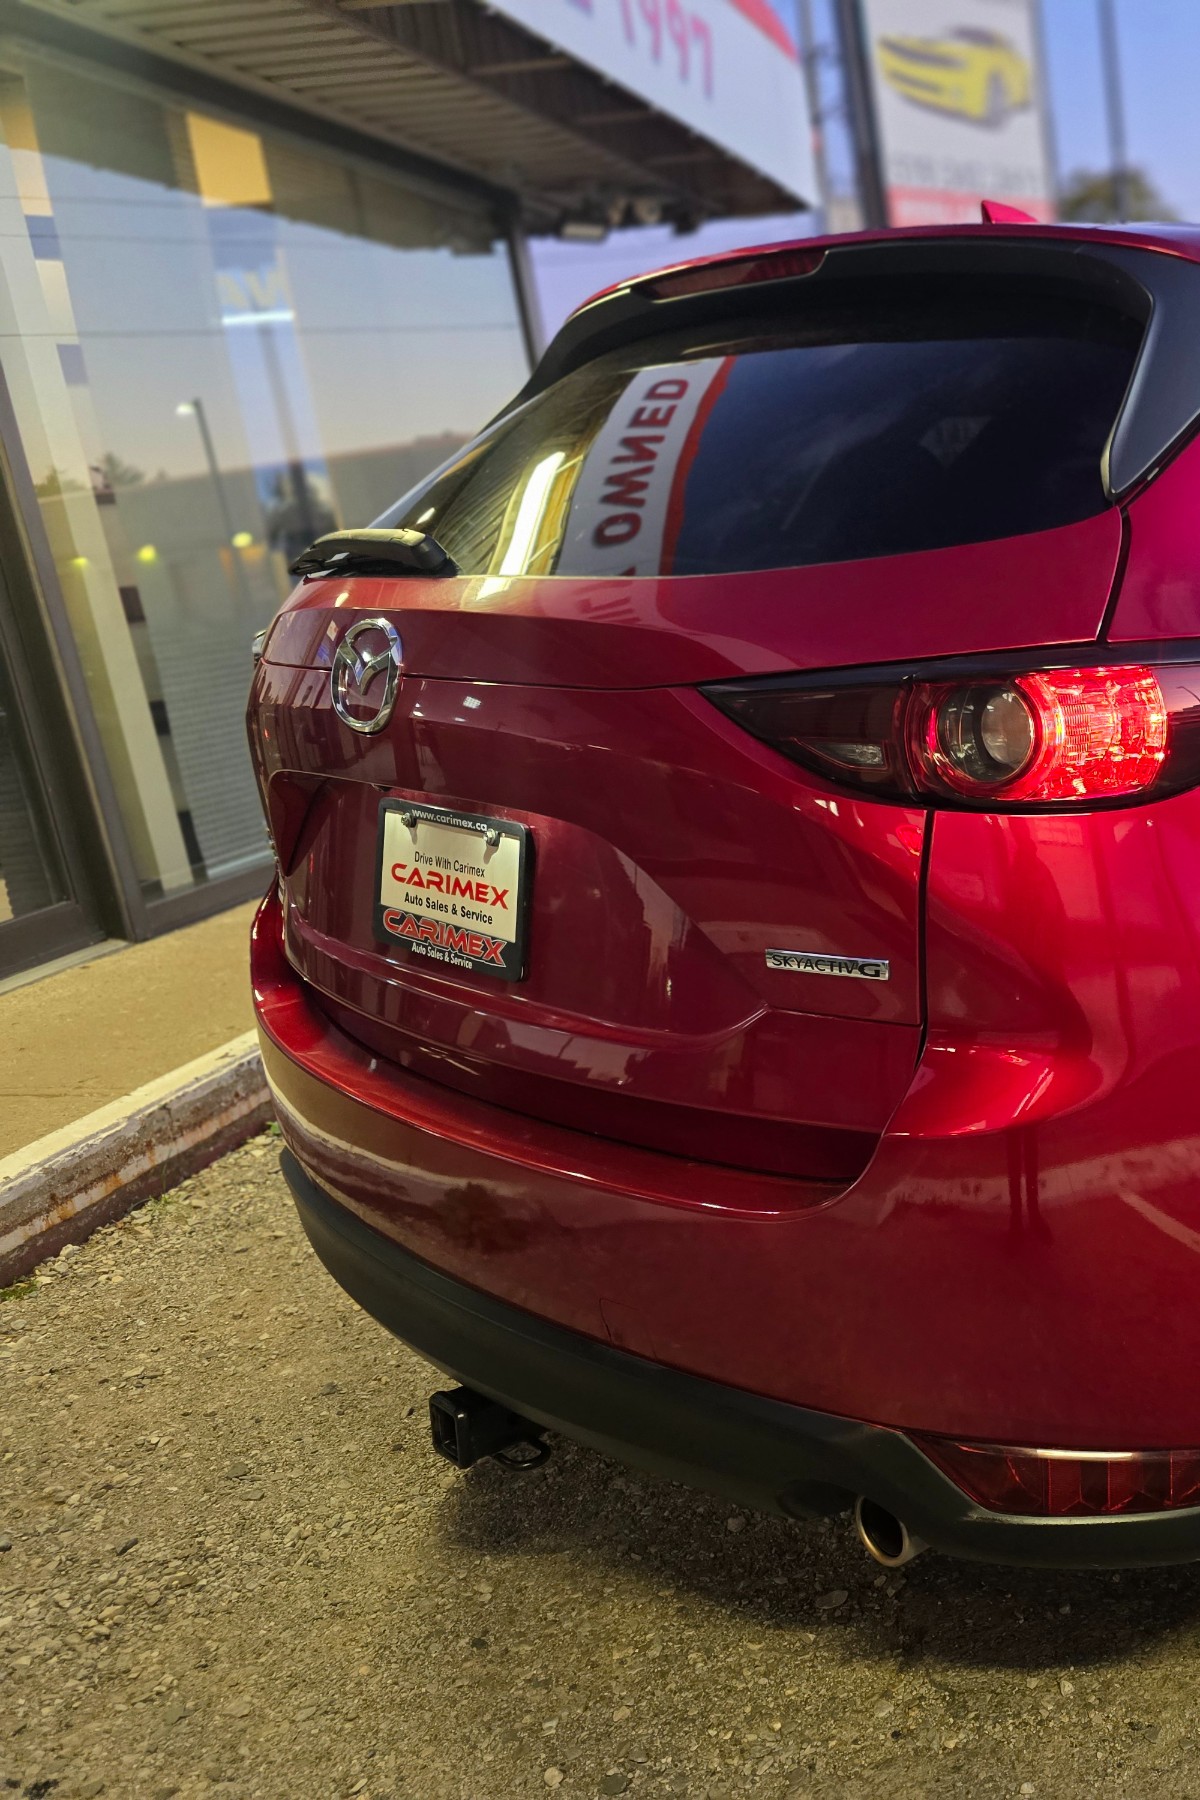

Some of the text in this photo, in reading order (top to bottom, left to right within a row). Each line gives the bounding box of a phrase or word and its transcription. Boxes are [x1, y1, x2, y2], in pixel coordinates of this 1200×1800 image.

[411, 809, 488, 832] www.carimex.ca
[414, 851, 486, 878] Drive With Carimex
[391, 863, 509, 910] CARIMEX
[404, 892, 493, 924] Auto Sales & Service
[383, 909, 506, 966] CARIMEX
[412, 942, 473, 969] Auto Sales & Service
